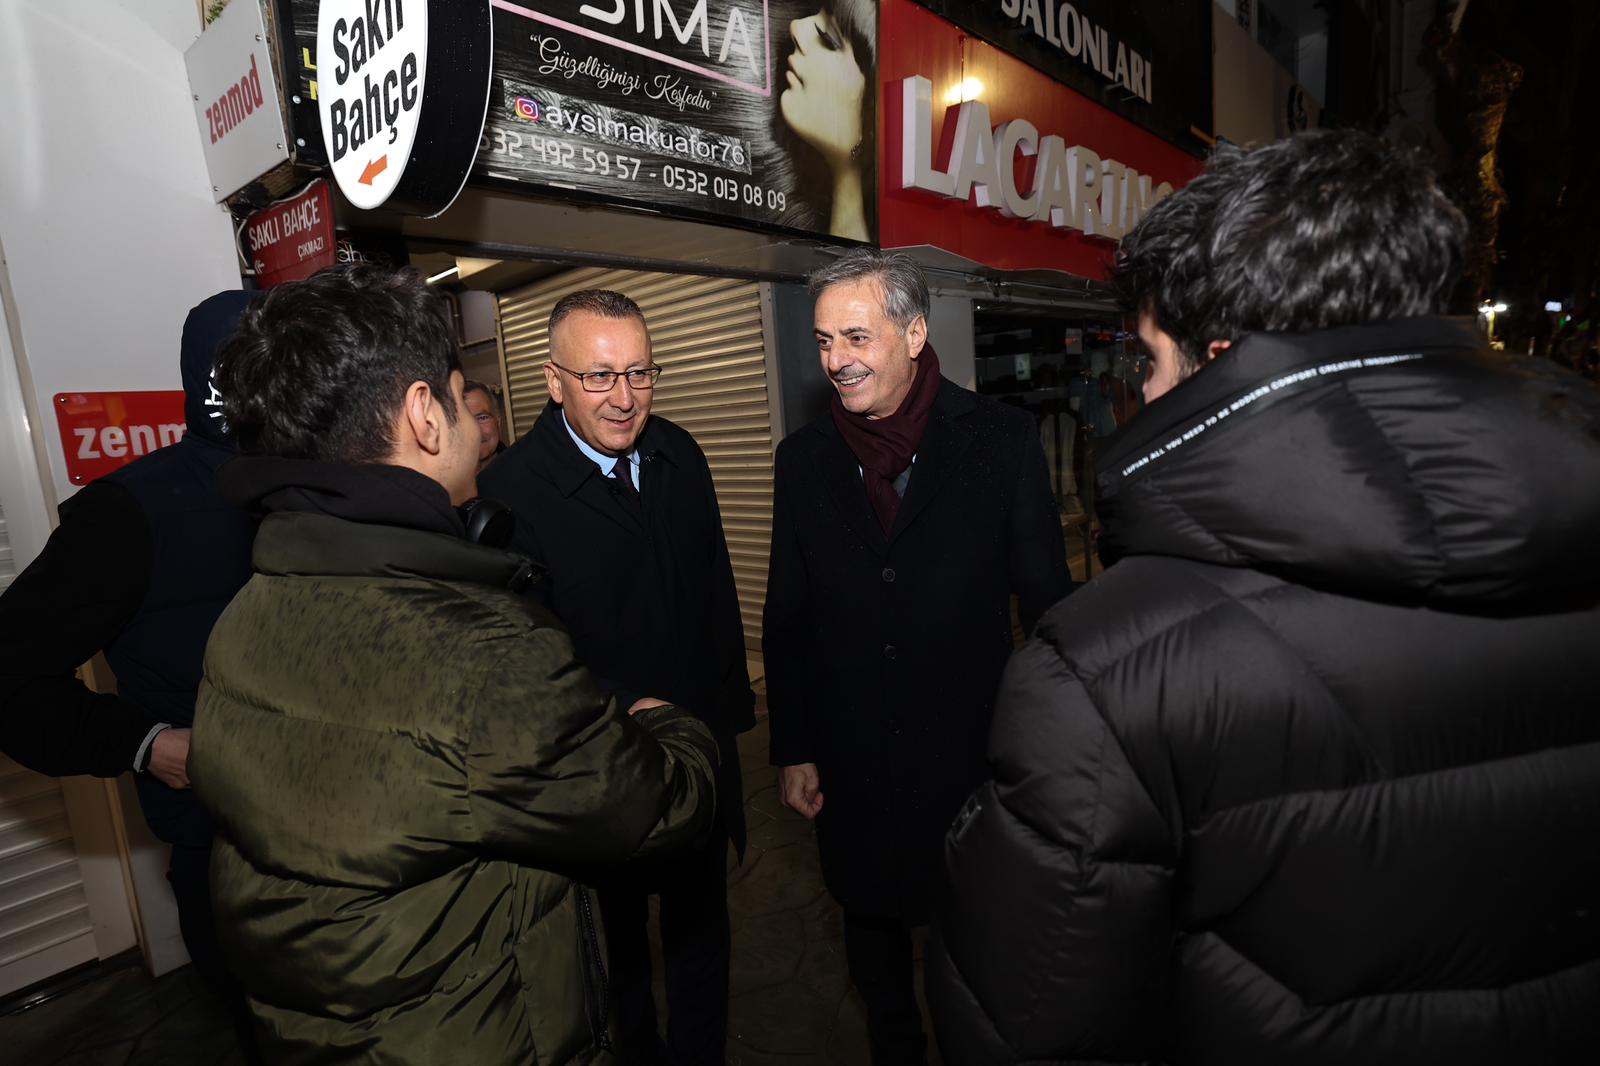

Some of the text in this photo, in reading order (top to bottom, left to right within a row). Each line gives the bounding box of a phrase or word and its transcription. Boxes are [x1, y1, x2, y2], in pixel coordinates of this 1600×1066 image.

[205, 53, 264, 145] zenmod
[330, 52, 418, 162] Bahçe
[545, 103, 745, 166] aysimakuafor76
[530, 134, 576, 169] 492
[583, 146, 610, 176] 59
[616, 154, 642, 181] 57
[663, 165, 708, 196] 0532
[713, 176, 738, 201] 013
[743, 183, 763, 207] 08
[767, 189, 786, 212] 09
[901, 74, 1174, 240] LACARIN
[249, 196, 320, 251] SAKLI BAHÇE
[298, 236, 324, 261] ÇIKMAZI
